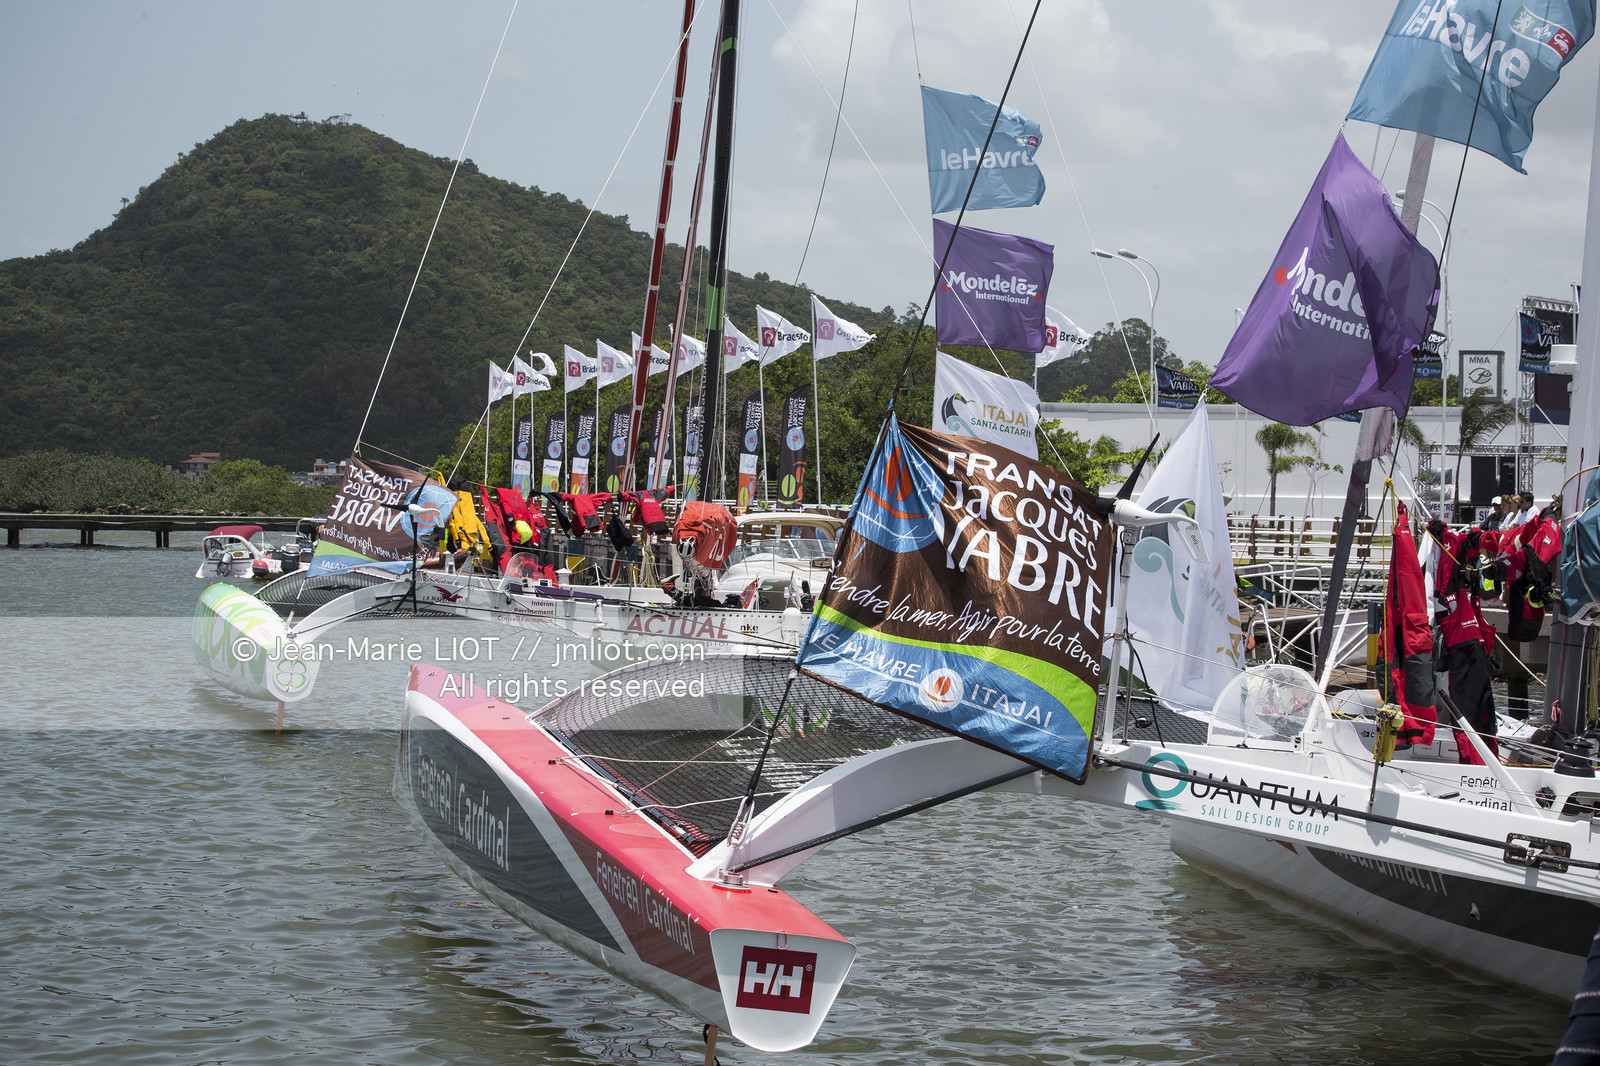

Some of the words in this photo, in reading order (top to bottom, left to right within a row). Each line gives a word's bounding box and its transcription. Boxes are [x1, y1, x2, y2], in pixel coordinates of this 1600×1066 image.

[1399, 0, 1531, 89] leHavre
[940, 147, 1036, 171] leHavre
[975, 290, 1030, 305] International
[1469, 356, 1490, 364] MMA
[971, 417, 998, 430] SANTA
[938, 447, 1102, 541] TRANSAT
[930, 501, 1103, 639] VABRE
[623, 613, 729, 640] ACTUAL
[740, 623, 759, 632] nke
[886, 593, 911, 622] la
[909, 608, 954, 631] mer,
[947, 600, 998, 643] Agir
[988, 615, 1049, 641] pour
[1043, 620, 1063, 651] la
[1064, 632, 1101, 677] terre
[842, 642, 922, 680] HAVRE
[971, 684, 1053, 728] ITAJAI
[1135, 752, 1340, 822] QUANTUM
[458, 782, 511, 872] Cardinal
[1201, 804, 1228, 820] SAIL
[1235, 810, 1282, 828] DESIGN
[1288, 819, 1330, 836] GROUP
[645, 888, 696, 956] Cardinal
[743, 960, 804, 998] HH
